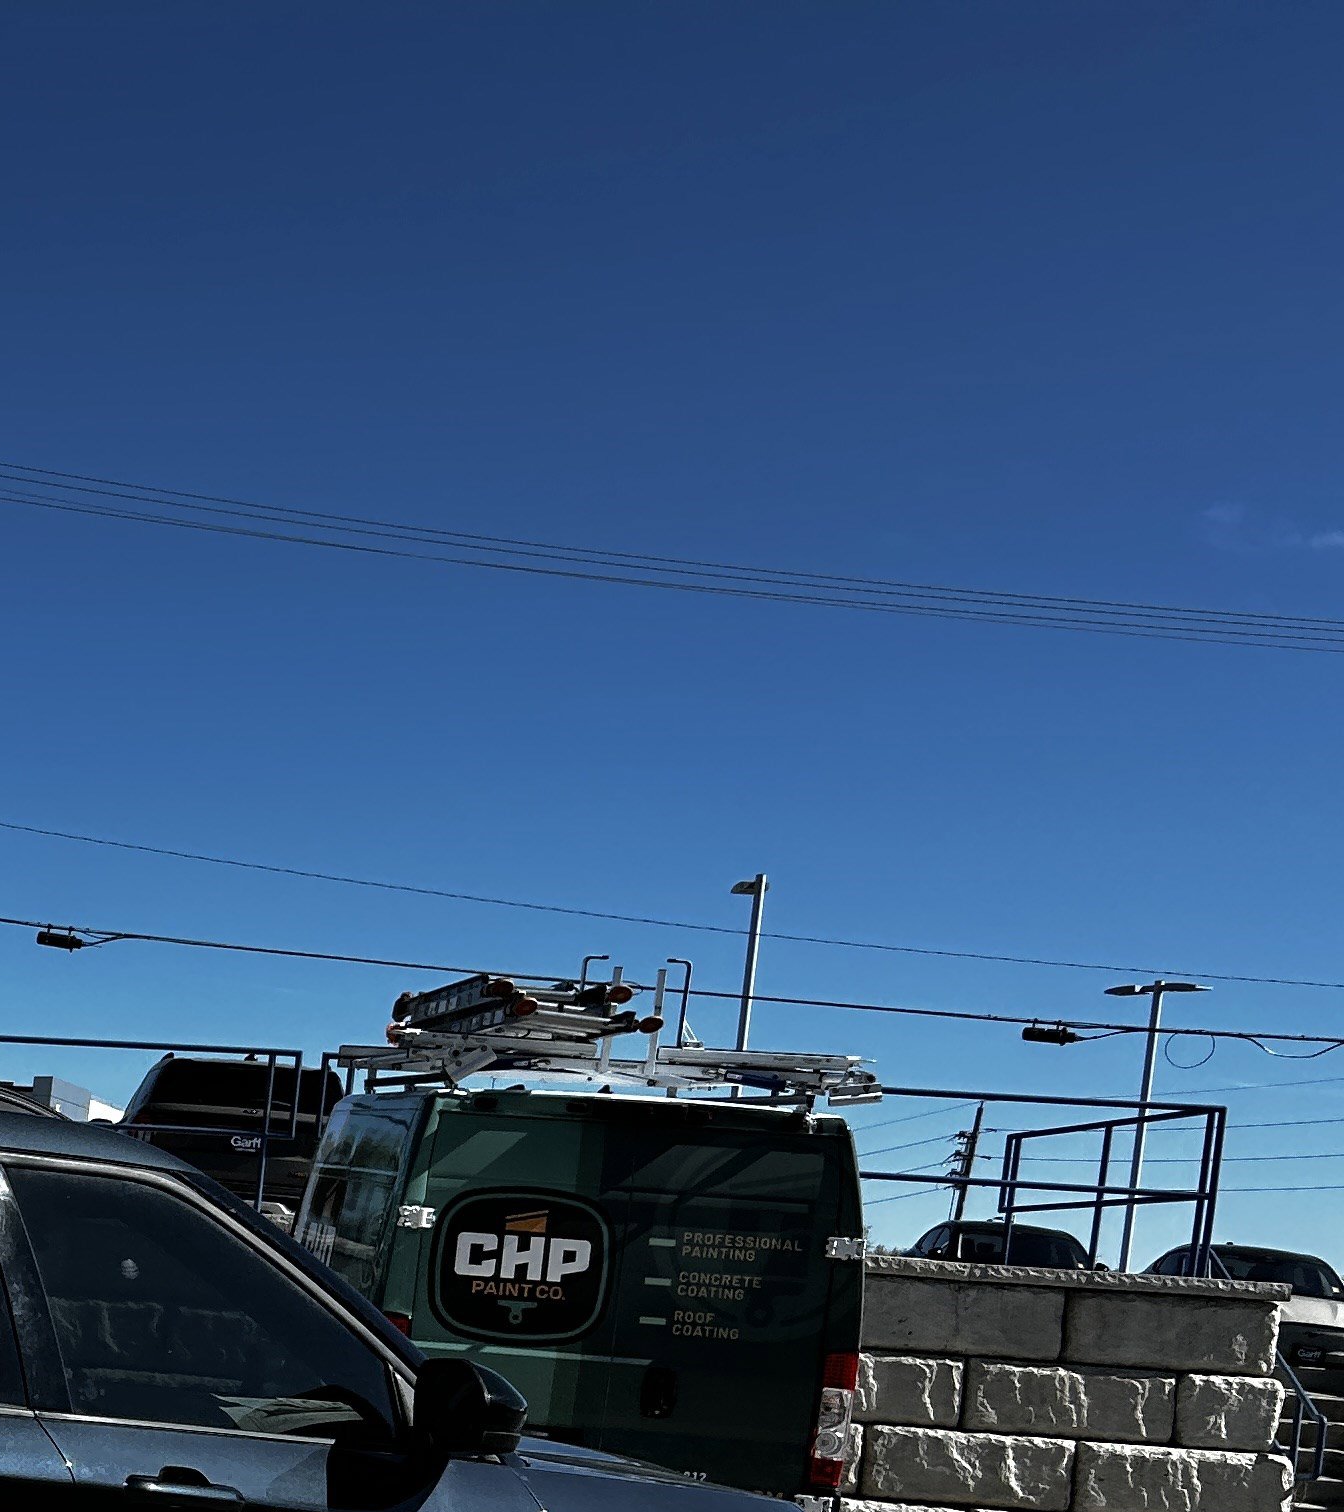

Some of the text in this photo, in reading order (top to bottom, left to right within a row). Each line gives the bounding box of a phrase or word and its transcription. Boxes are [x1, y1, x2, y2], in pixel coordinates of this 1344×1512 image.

[231, 1136, 261, 1148] Garff
[683, 1231, 803, 1252] PROFESSIONAL
[454, 1231, 592, 1283] CHP
[681, 1245, 757, 1262] PAINTING
[678, 1271, 762, 1289] CONCRETE
[472, 1280, 566, 1301] PAINT CO.
[677, 1284, 745, 1301] COATING
[673, 1310, 715, 1324] ROOF
[671, 1323, 740, 1340] COATING
